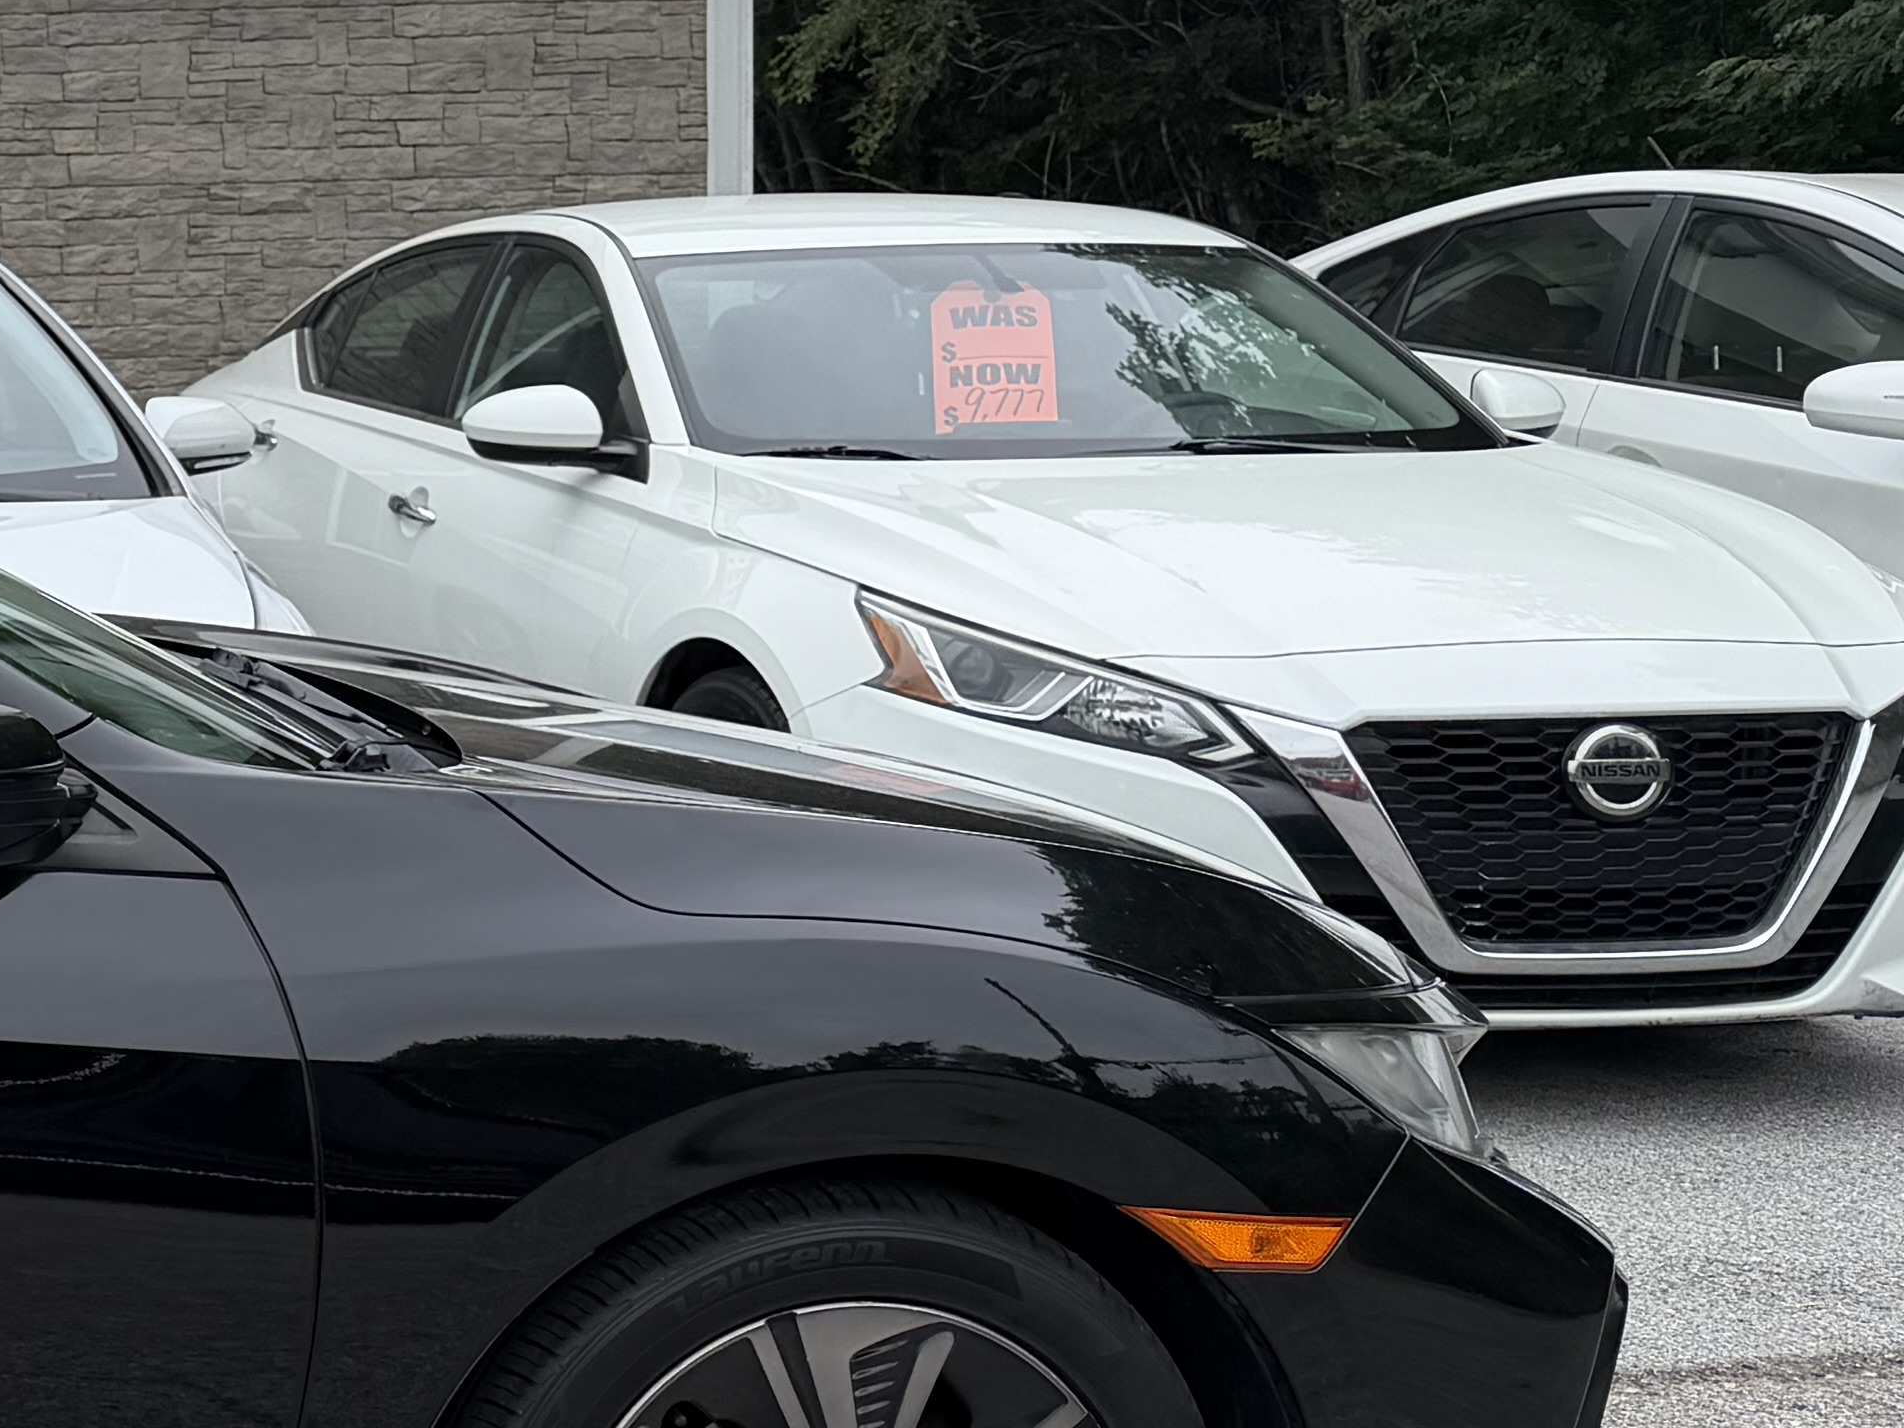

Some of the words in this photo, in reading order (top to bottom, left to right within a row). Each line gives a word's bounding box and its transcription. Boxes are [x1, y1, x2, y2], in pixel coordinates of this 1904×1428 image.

[949, 304, 1038, 330] WAS
[949, 362, 1042, 389] NOW
[1580, 763, 1661, 777] NISSAN
